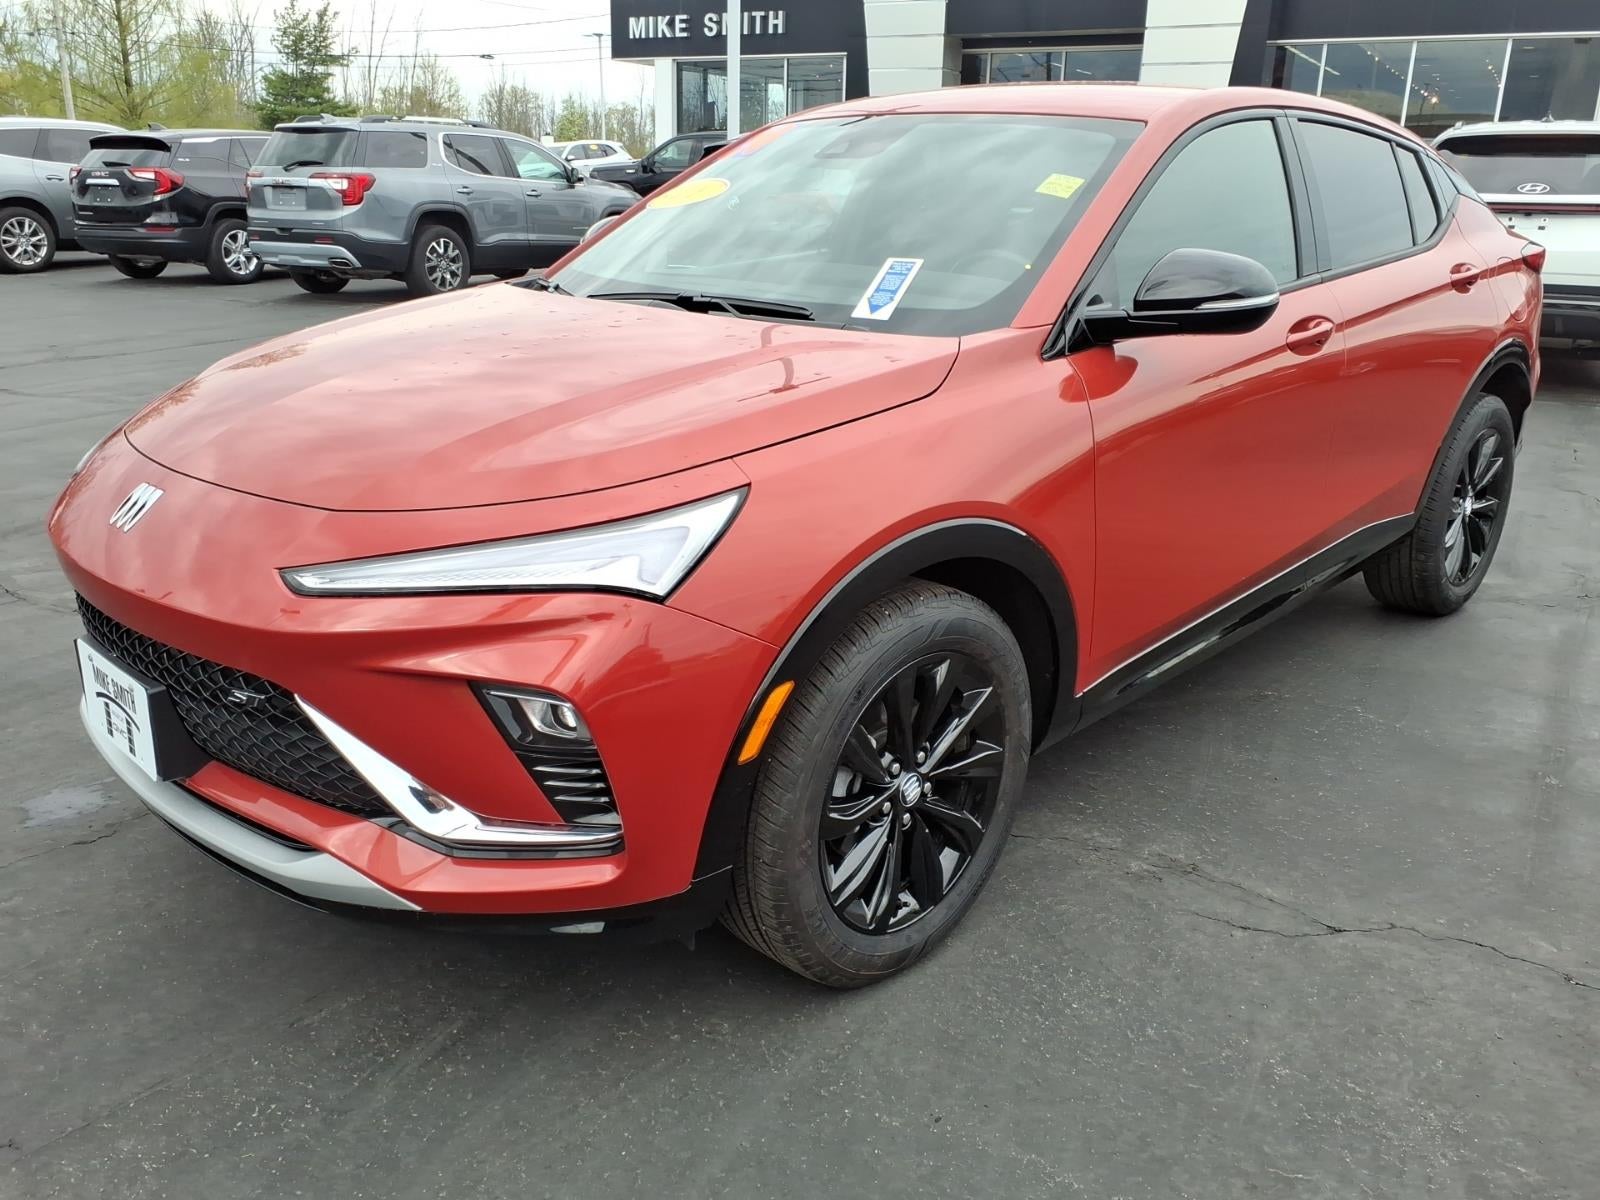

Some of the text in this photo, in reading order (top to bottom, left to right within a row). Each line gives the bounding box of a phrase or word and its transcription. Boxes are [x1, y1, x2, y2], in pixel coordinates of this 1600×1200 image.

[628, 14, 690, 39] MIKE
[92, 663, 137, 715] MIKE SMITH
